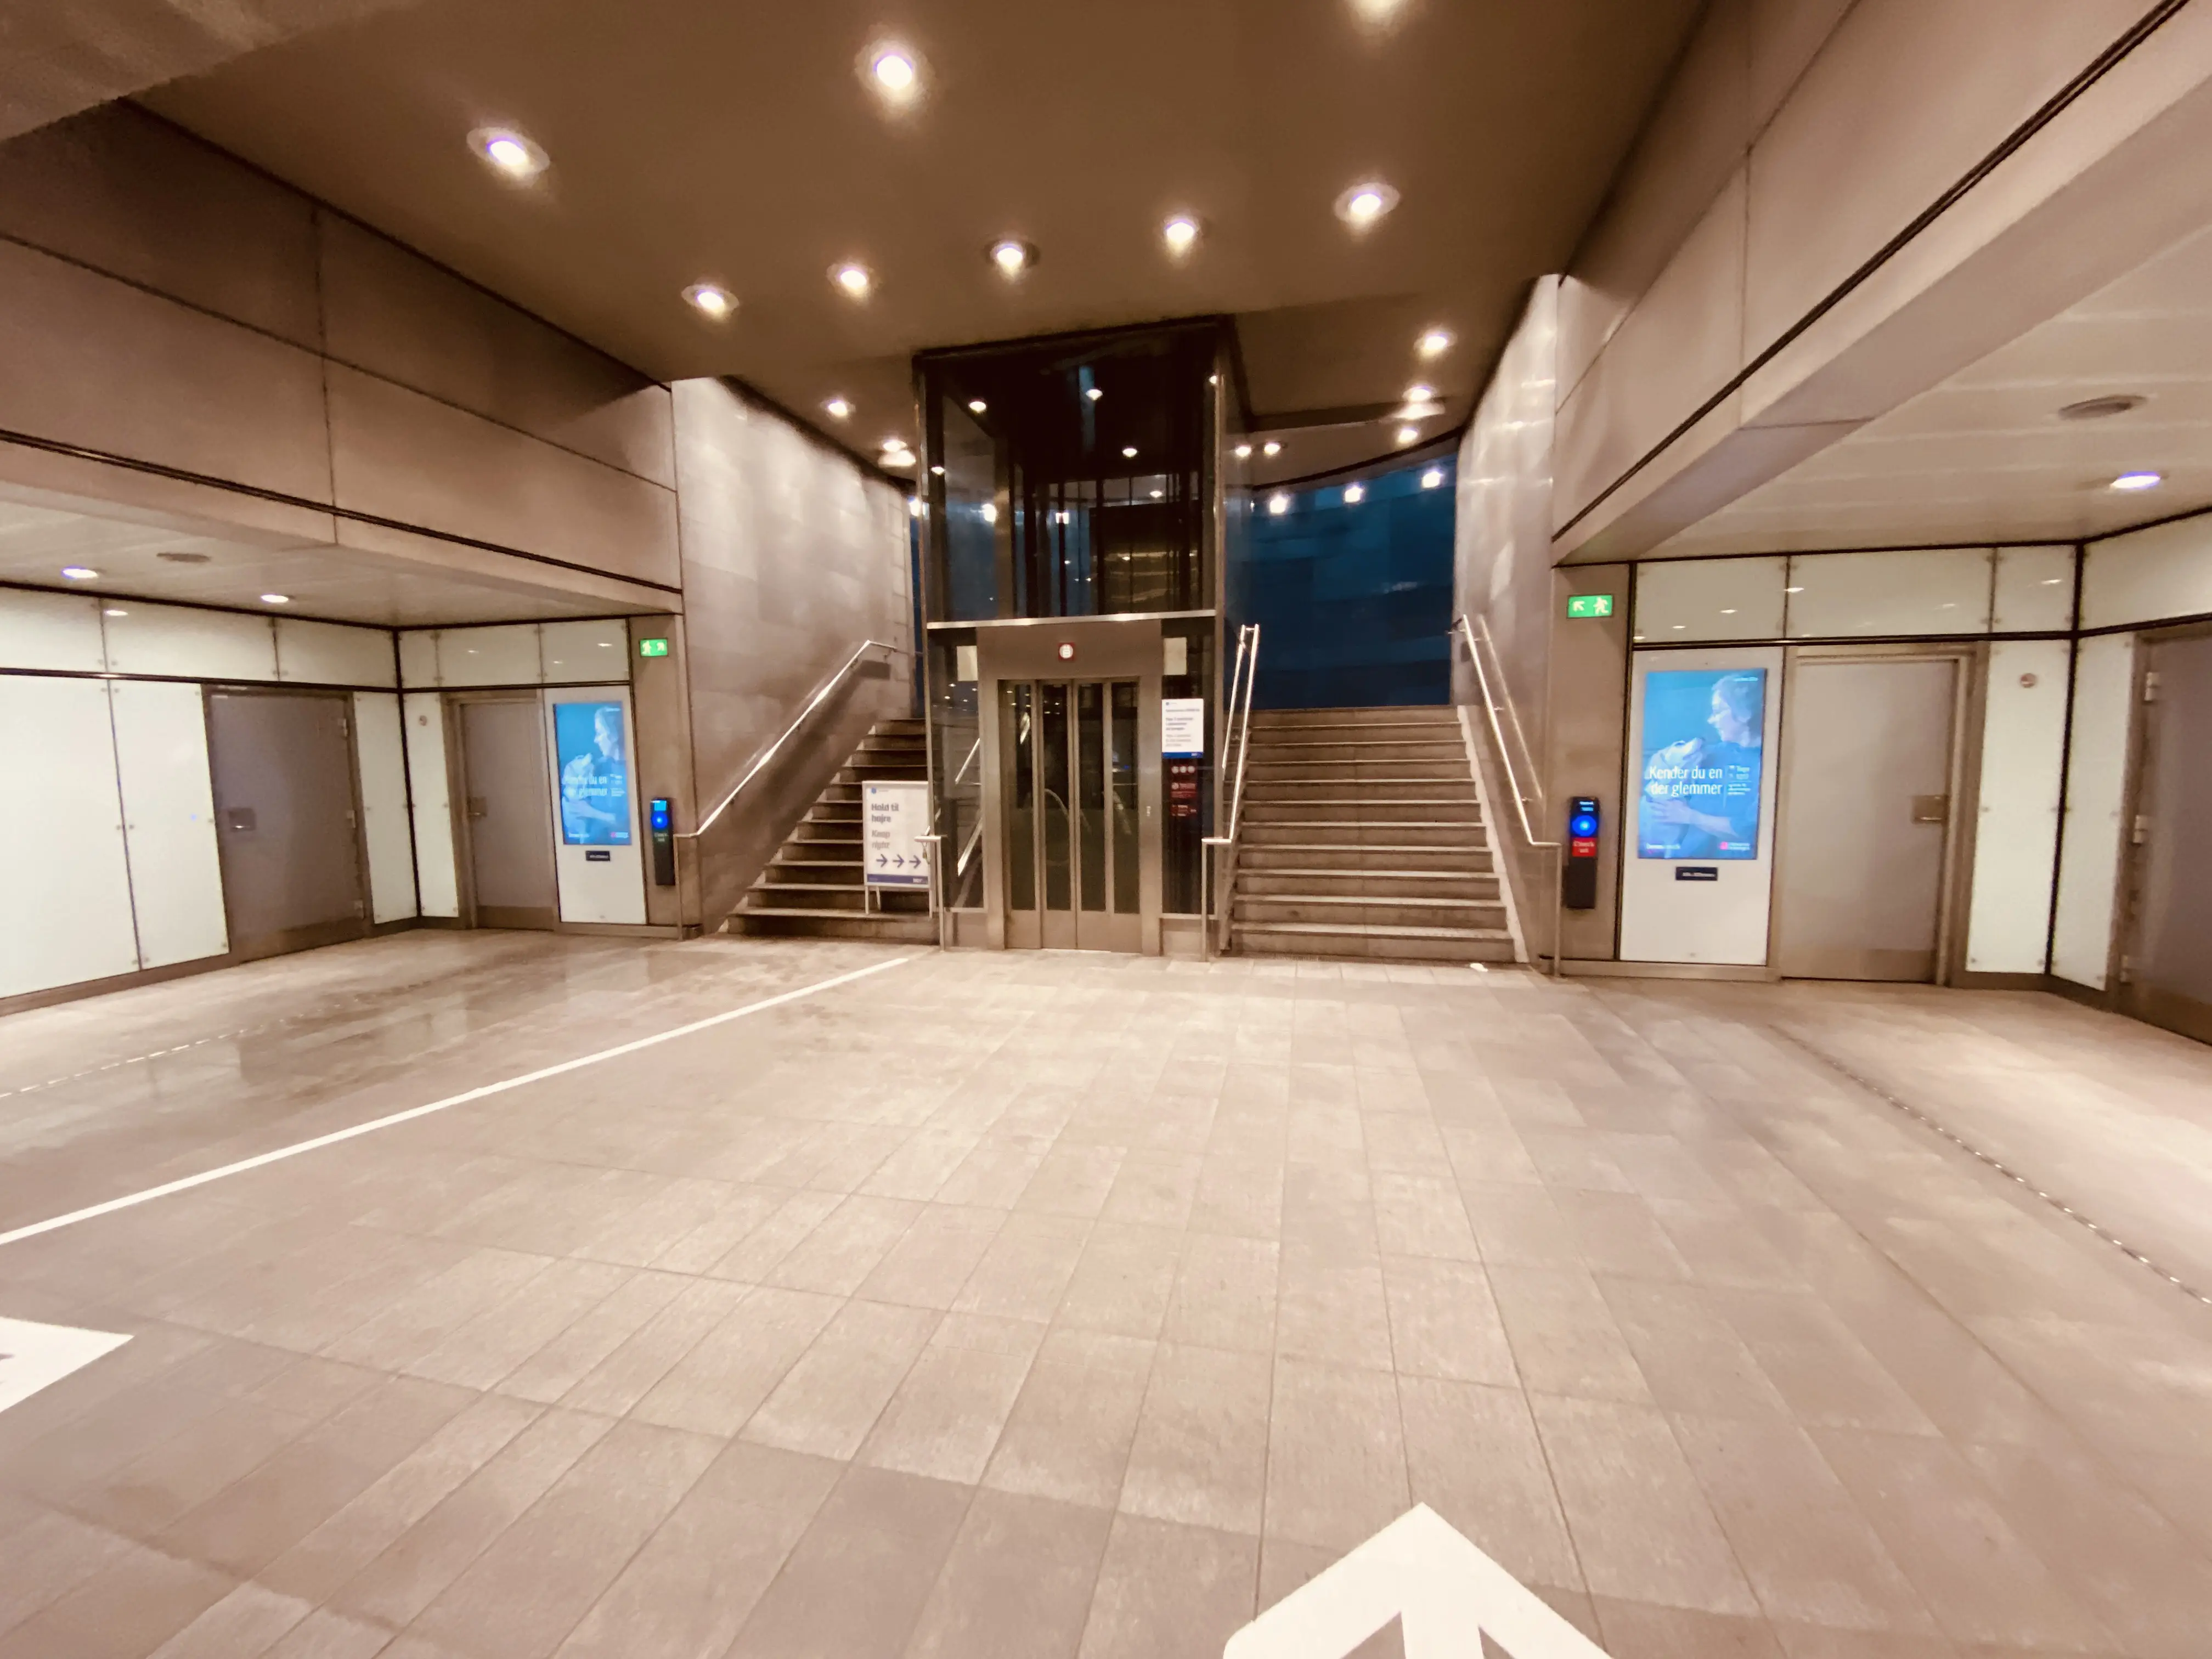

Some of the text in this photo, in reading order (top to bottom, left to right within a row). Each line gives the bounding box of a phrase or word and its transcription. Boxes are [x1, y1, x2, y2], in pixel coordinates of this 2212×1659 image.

[1650, 766, 1688, 779] Kender
[1691, 766, 1706, 779] du
[1709, 768, 1723, 778] en
[599, 776, 607, 784] en
[1651, 781, 1669, 794] der
[1671, 781, 1723, 797] glemmer
